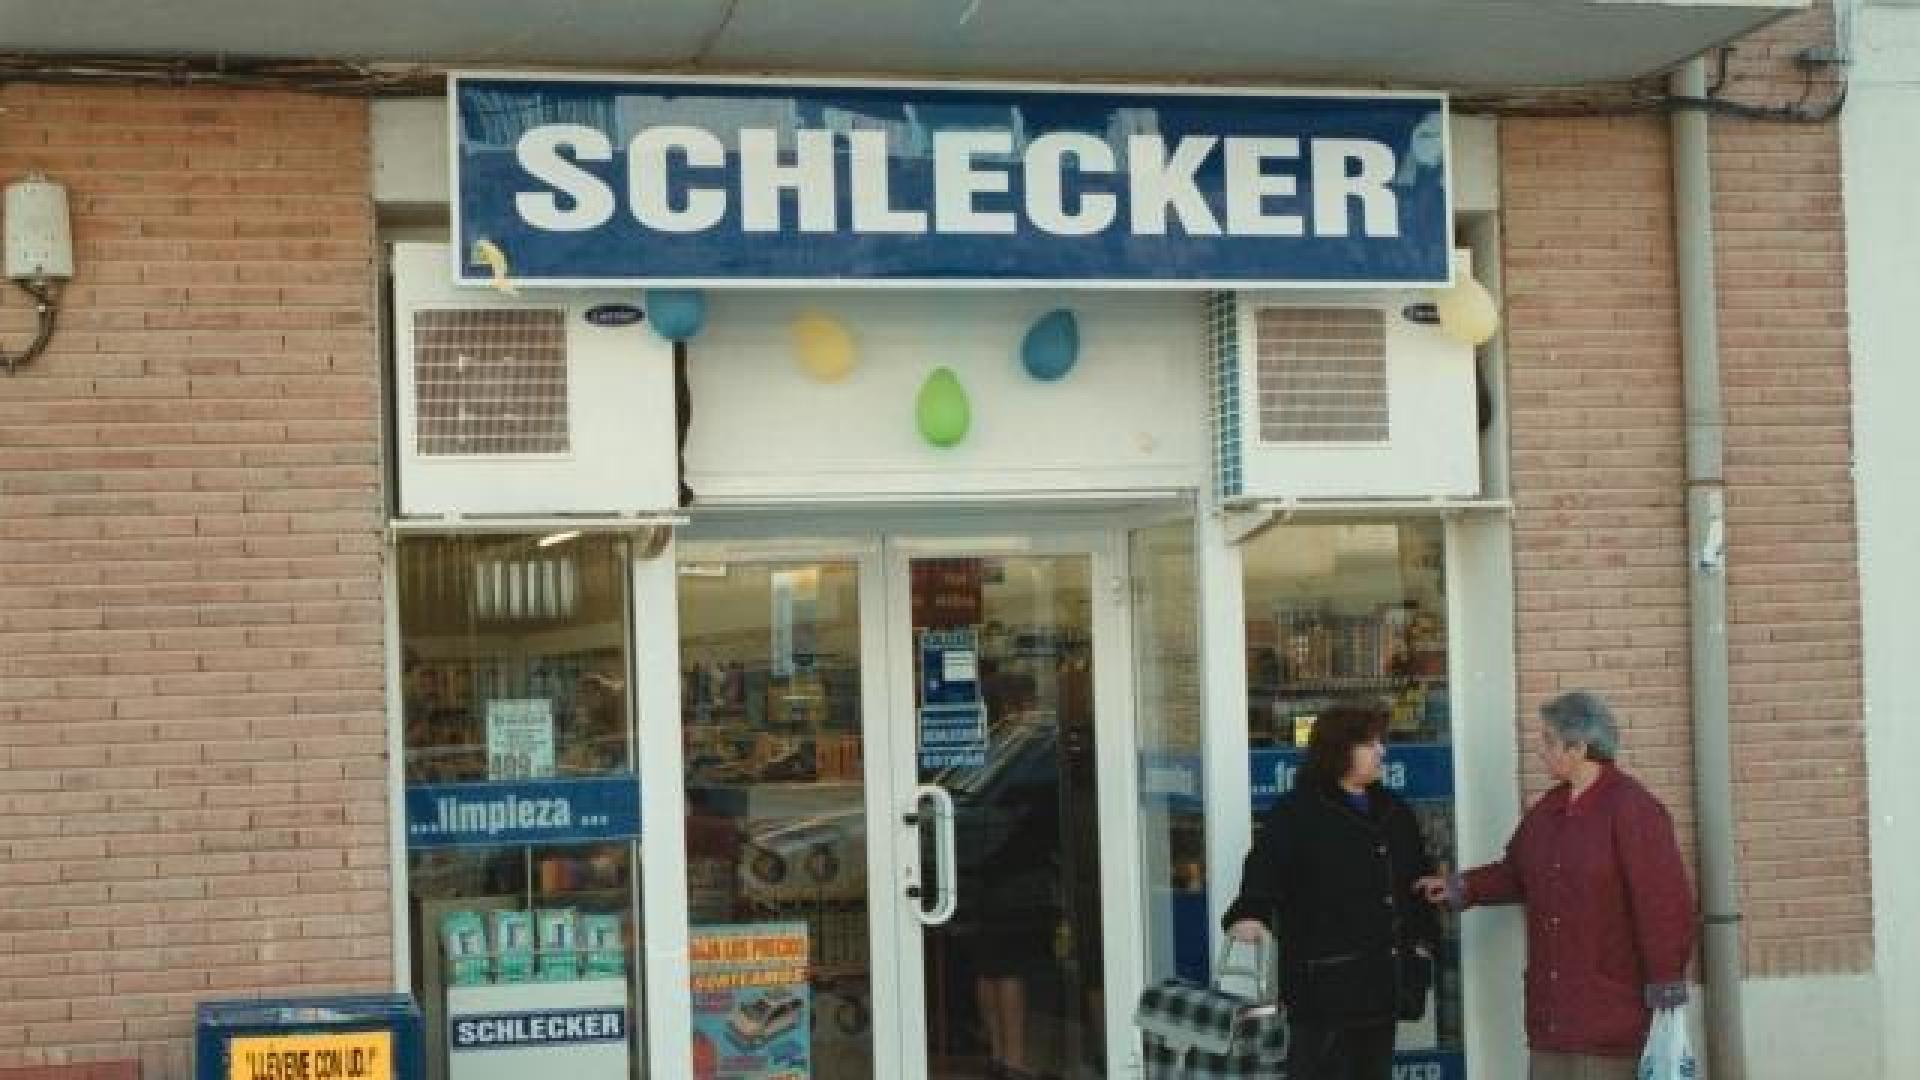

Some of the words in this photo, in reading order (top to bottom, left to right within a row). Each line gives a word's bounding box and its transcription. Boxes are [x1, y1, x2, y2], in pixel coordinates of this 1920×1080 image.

[515, 125, 1400, 236] SCHLECKER
[457, 1013, 620, 1045] SCHLECKER
[314, 1049, 342, 1079] CON
